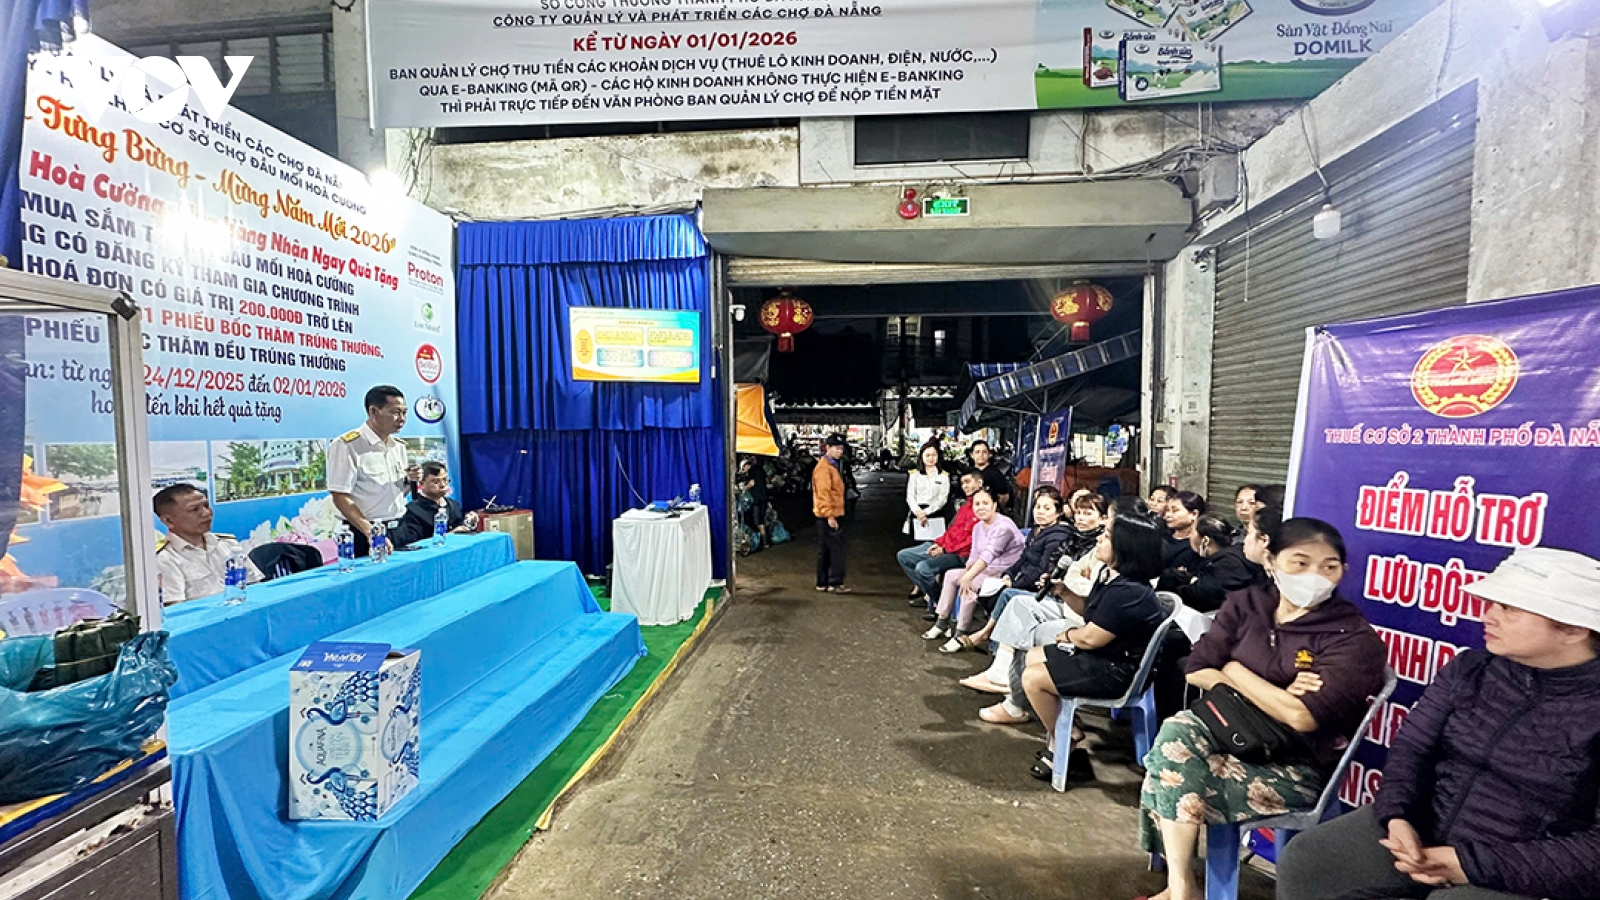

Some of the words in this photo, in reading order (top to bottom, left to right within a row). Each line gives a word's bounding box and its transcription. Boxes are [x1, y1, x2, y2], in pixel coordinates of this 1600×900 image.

[493, 14, 535, 27] CÔNG
[539, 15, 557, 25] TY
[562, 11, 603, 25] QUẢN
[607, 11, 623, 23] LÝ
[628, 10, 647, 22] VÀ
[652, 8, 690, 21] PHÁT
[694, 5, 737, 20] TRIỂN
[741, 6, 772, 19] CÁC
[777, 7, 809, 20] CHỢ
[814, 5, 835, 17] ĐÀ
[839, 1, 882, 16] NẴNG
[1276, 23, 1303, 38] Sản
[1304, 22, 1327, 38] Vật
[1368, 20, 1393, 33] Nai
[573, 30, 598, 51] KỂ
[601, 32, 628, 50] TỪ
[630, 31, 682, 49] NGÀY
[686, 31, 798, 51] 01/01/2026
[1294, 39, 1373, 56] DOMILK
[389, 68, 417, 80] BAN
[420, 63, 458, 79] QUẢN
[461, 62, 477, 77] LÝ
[479, 63, 509, 79] CHỢ
[513, 64, 540, 76] THU
[577, 59, 606, 73] CÁC
[609, 57, 658, 72] KHOẢN
[662, 58, 696, 73] DỊCH
[699, 58, 718, 72] VỤ
[722, 54, 765, 71] (THUÊ
[768, 53, 788, 67] LÔ
[791, 54, 825, 67] KINH
[828, 53, 884, 66] DOANH,
[888, 50, 926, 67] ĐIỆN,
[419, 84, 449, 97] QUA
[452, 82, 528, 95] E-BANKING
[531, 78, 558, 95] (MÃ
[561, 78, 587, 93] QR)
[601, 76, 631, 90] CÁC
[634, 75, 654, 92] HỘ
[657, 77, 690, 89] KINH
[693, 76, 743, 88] DOANH
[747, 72, 798, 86] KHÔNG
[801, 71, 841, 88] THỰC
[844, 68, 877, 86] HIỆN
[880, 69, 964, 83] E-BANKING
[440, 99, 462, 113] THÌ
[465, 97, 496, 112] PHẢI
[499, 99, 536, 114] TRỰC
[539, 93, 569, 110] TIẾP
[571, 93, 599, 109] ĐẾN
[602, 94, 632, 108] VĂN
[634, 92, 684, 107] PHÒNG
[687, 94, 717, 106] BAN
[719, 89, 761, 105] QUẢN
[764, 89, 779, 104] LÝ
[783, 90, 815, 106] CHỢ
[818, 85, 838, 102] ĐỂ
[840, 87, 871, 104] NỘP
[910, 85, 941, 102] MẶT
[188, 127, 210, 147] SỞ
[214, 140, 247, 166] CHỢ
[250, 156, 276, 177] ĐẦU
[279, 169, 303, 188] MỐI
[306, 181, 329, 200] HOÀ
[245, 136, 274, 158] CÁC
[278, 153, 304, 173] CHỢ
[307, 163, 323, 182] ĐÀ
[122, 128, 190, 189] Bừng
[212, 168, 270, 219] Mừng
[273, 188, 316, 228] Năm
[318, 210, 348, 240] Mới
[29, 150, 86, 192] Hoà
[93, 173, 166, 218] Cường
[270, 231, 309, 264] Nhận
[311, 245, 346, 275] Ngay
[349, 257, 372, 280] Quà
[374, 263, 399, 290] Tặng
[20, 189, 78, 223] MUA
[85, 207, 136, 239] SẮM
[255, 256, 283, 278] MỐI
[287, 263, 314, 285] HOÀ
[316, 273, 355, 296] CƯỜNG
[26, 253, 79, 283] HOÁ
[86, 265, 134, 293] ĐƠN
[140, 277, 167, 299] CÓ
[174, 284, 204, 307] GIÁ
[208, 292, 234, 316] TRỊ
[239, 299, 303, 326] 200.000Đ
[306, 311, 330, 330] TRỞ
[332, 316, 354, 334] LÊN
[54, 229, 88, 254] CÓ
[95, 240, 155, 270] ĐĂNG
[161, 256, 185, 276] KÝ
[191, 263, 238, 290] THAM
[243, 276, 268, 297] GIA
[272, 282, 324, 309] CHƯƠNG
[327, 294, 360, 317] TRÌNH
[407, 261, 444, 287] Proton
[25, 317, 100, 344] PHIẾU
[157, 334, 209, 357] THĂM
[250, 347, 296, 367] TRÚNG
[299, 352, 346, 372] THƯỞNG
[161, 308, 215, 334] PHIẾU
[220, 316, 251, 338] BỐC
[256, 324, 295, 346] THĂM
[298, 331, 338, 351] TRÚNG
[61, 359, 87, 383] từ
[144, 364, 245, 392] 24/12/2025
[248, 373, 271, 394] đến
[273, 376, 346, 398] 02/01/2026
[174, 394, 202, 417] khi
[203, 395, 226, 417] hết
[228, 400, 252, 423] quà
[255, 402, 282, 423] tặng
[1324, 422, 1364, 444] THUẾ
[1363, 427, 1387, 444] CƠ
[1388, 422, 1412, 445] SỞ
[1412, 428, 1424, 445] 2
[1426, 424, 1487, 446] THÀNH
[1488, 422, 1535, 446] PHỐ
[1535, 423, 1565, 447] ĐÀ
[1358, 473, 1427, 534] ĐIỂM
[1429, 478, 1472, 539] HỖ
[1366, 557, 1423, 605] LƯU
[1422, 561, 1491, 624] ĐỘN
[1375, 628, 1431, 684] INH
